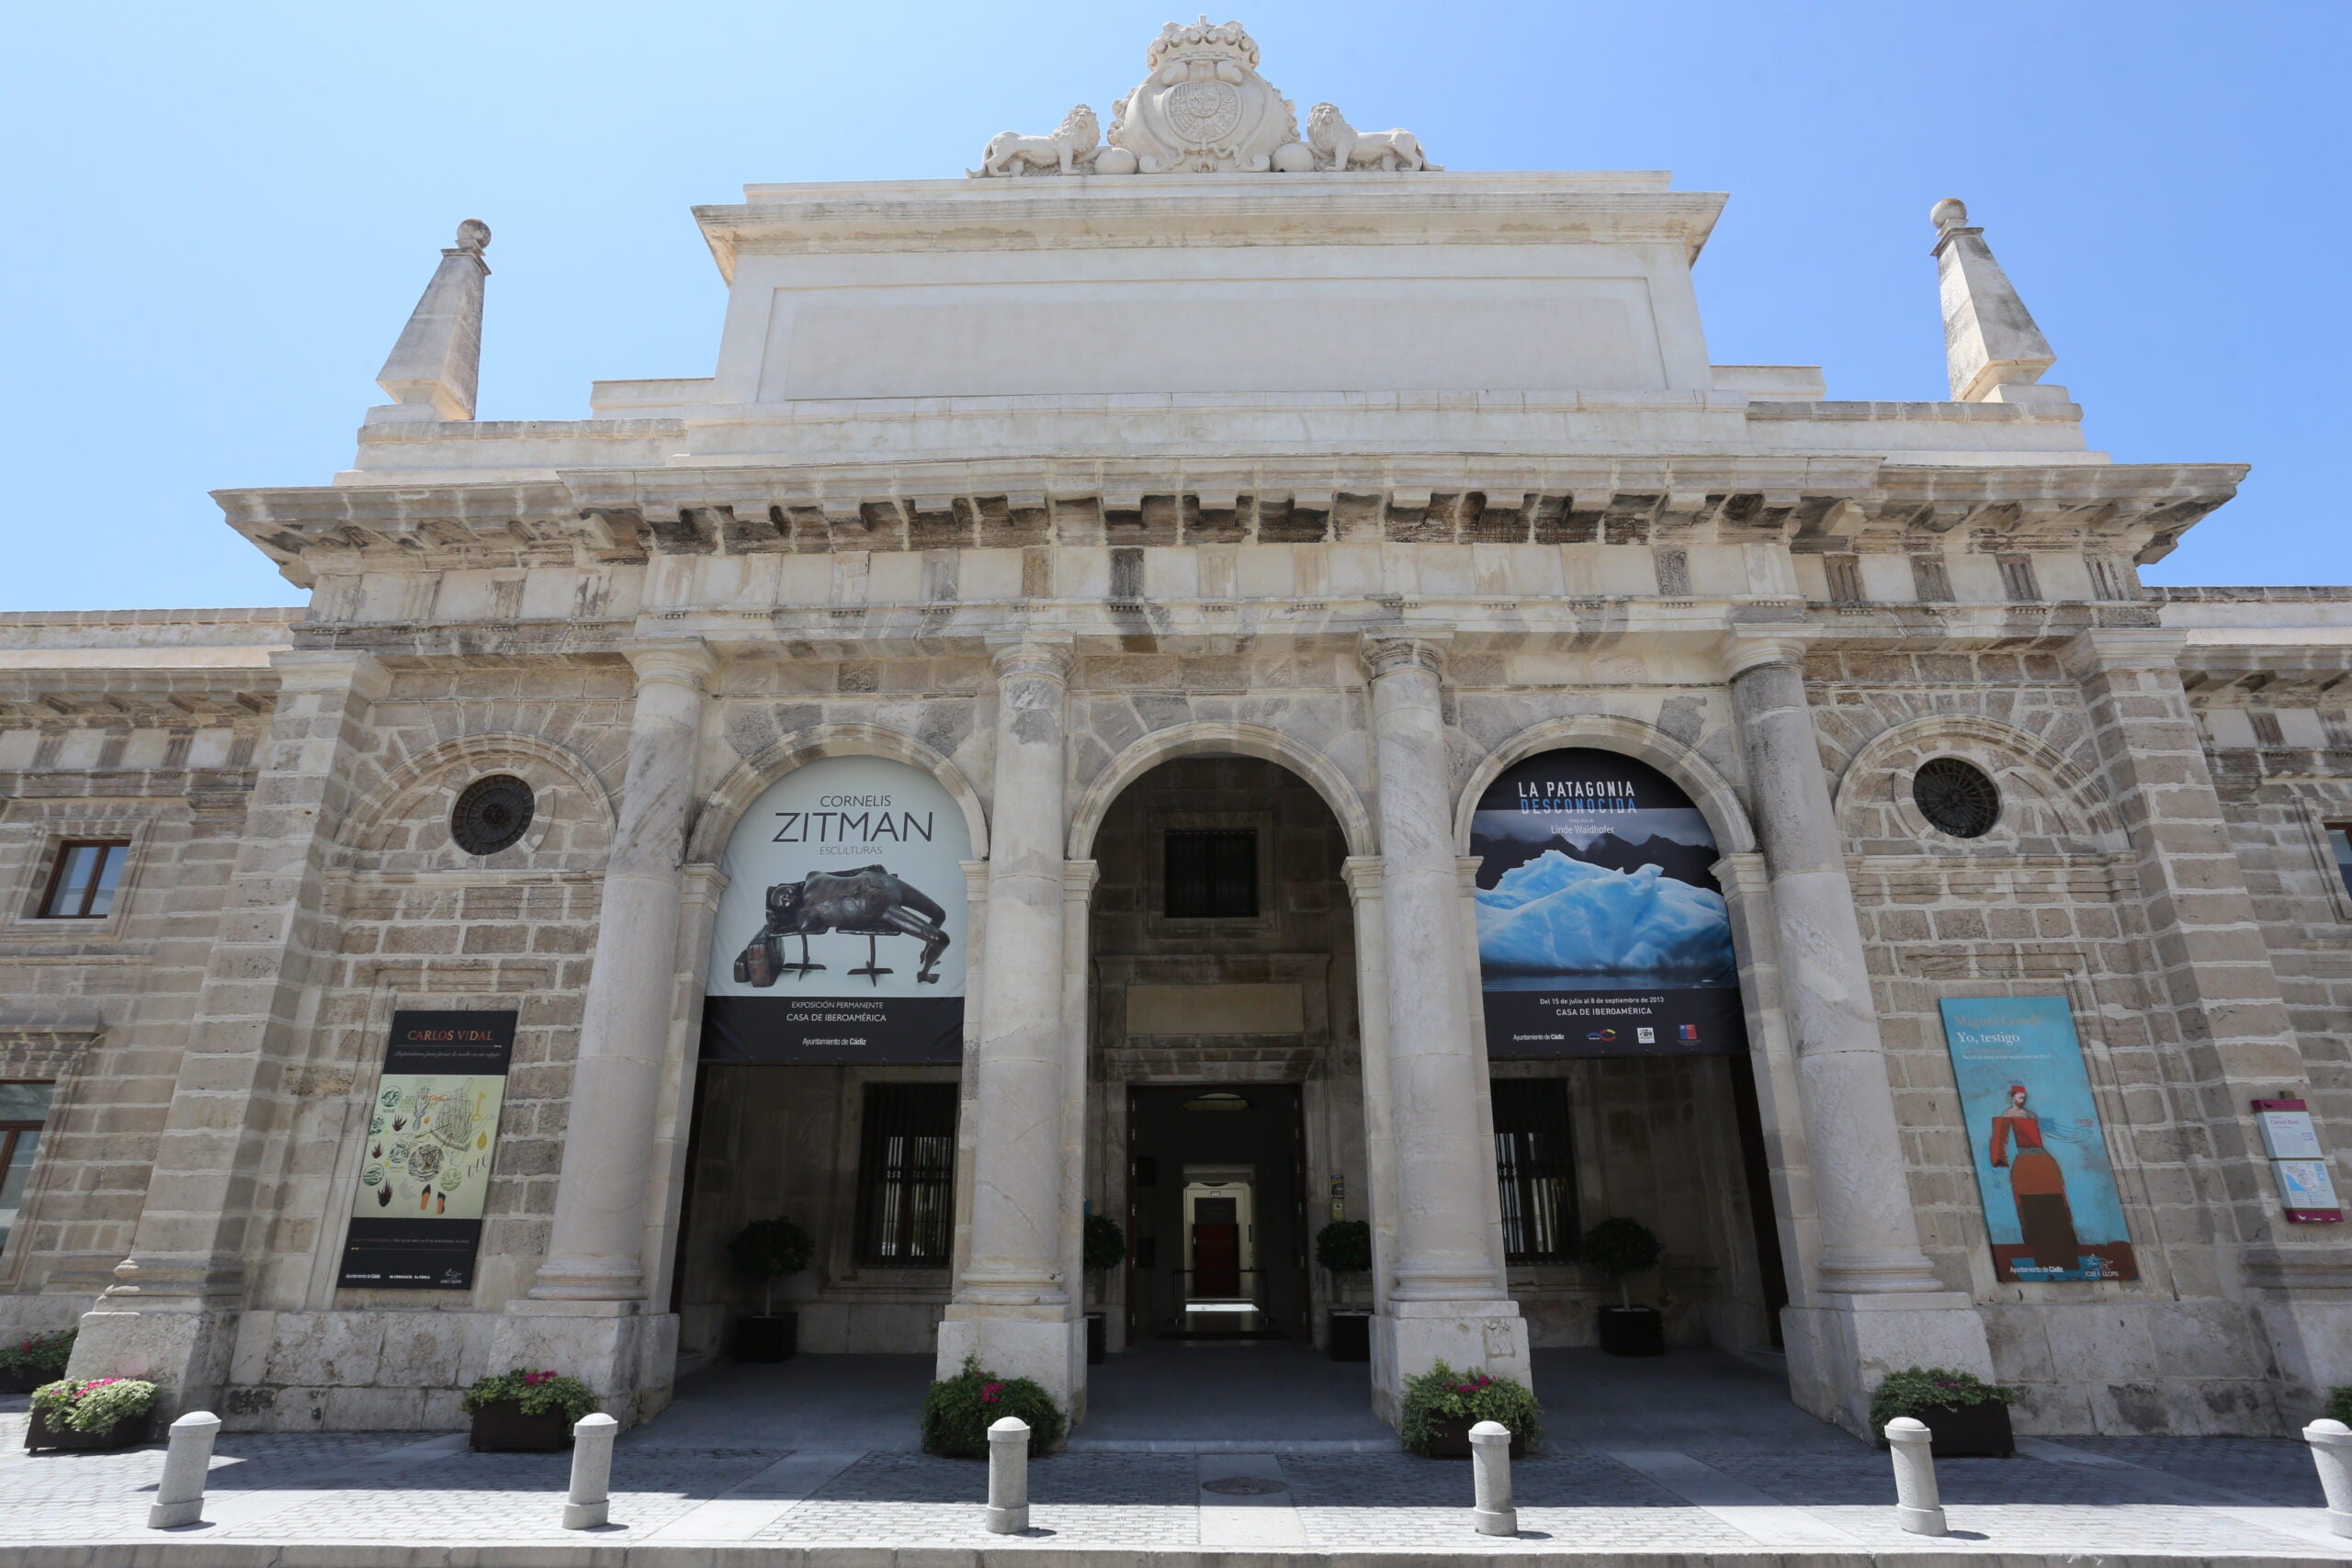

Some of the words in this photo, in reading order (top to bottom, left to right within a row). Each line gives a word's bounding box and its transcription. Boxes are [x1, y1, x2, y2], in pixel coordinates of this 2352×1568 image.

[1518, 782, 1539, 797] LA
[1546, 781, 1635, 797] PATAGONIA
[820, 795, 891, 807] CORNELIS
[1521, 797, 1638, 815] DESCONOCIDA
[772, 811, 933, 842] ZITMAN
[1551, 825, 1573, 834] Linde
[1575, 825, 1614, 834] Waidhofer
[820, 846, 883, 855] ESCULTURAS
[791, 1000, 835, 1009] EXPOSICIÓN
[1568, 998, 1582, 1006] julio
[1604, 997, 1640, 1005] septiembre
[1592, 1006, 1653, 1015] IBEROAMÉRICA
[786, 1013, 809, 1021] CASA
[811, 1013, 823, 1021] DE
[825, 1012, 887, 1021] IBEROAMÉRICA
[407, 1030, 455, 1041] CARLOS
[458, 1030, 493, 1041] VIDAL
[1513, 1033, 1544, 1042] Ayuntamiento
[1956, 1032, 1979, 1043] Yo,
[1981, 1032, 2020, 1046] testigo
[802, 1037, 841, 1047] Ayuntamiento
[849, 1037, 867, 1045] Cádiz
[2010, 1266, 2041, 1274] Ayuntamiento
